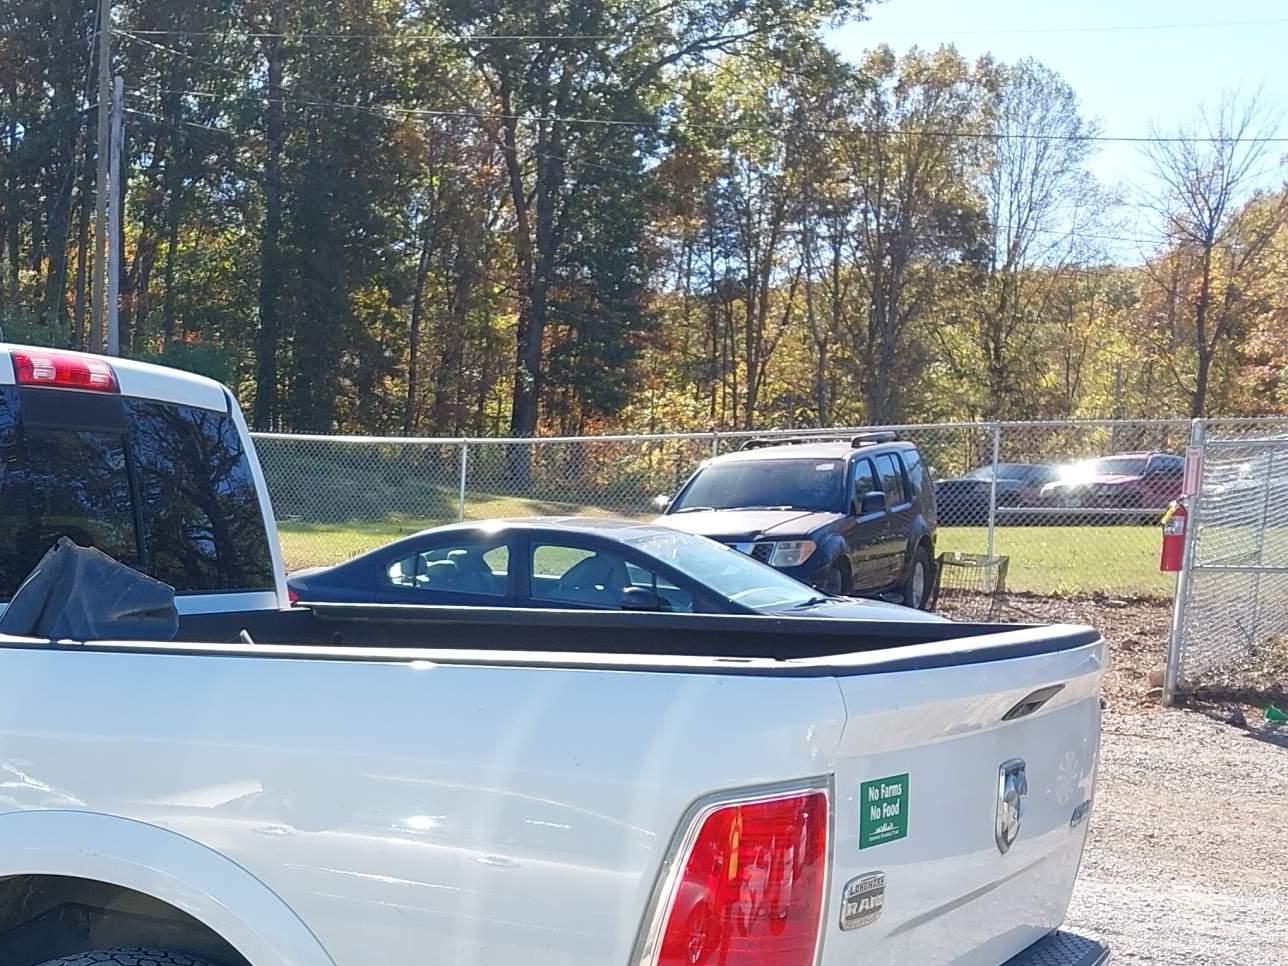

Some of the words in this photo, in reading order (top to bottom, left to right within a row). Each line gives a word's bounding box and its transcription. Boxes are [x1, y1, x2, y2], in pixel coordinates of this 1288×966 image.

[868, 786, 880, 802] No
[880, 783, 903, 800] Farms
[870, 805, 882, 822] No
[882, 798, 900, 818] Food
[846, 894, 884, 917] RAM
